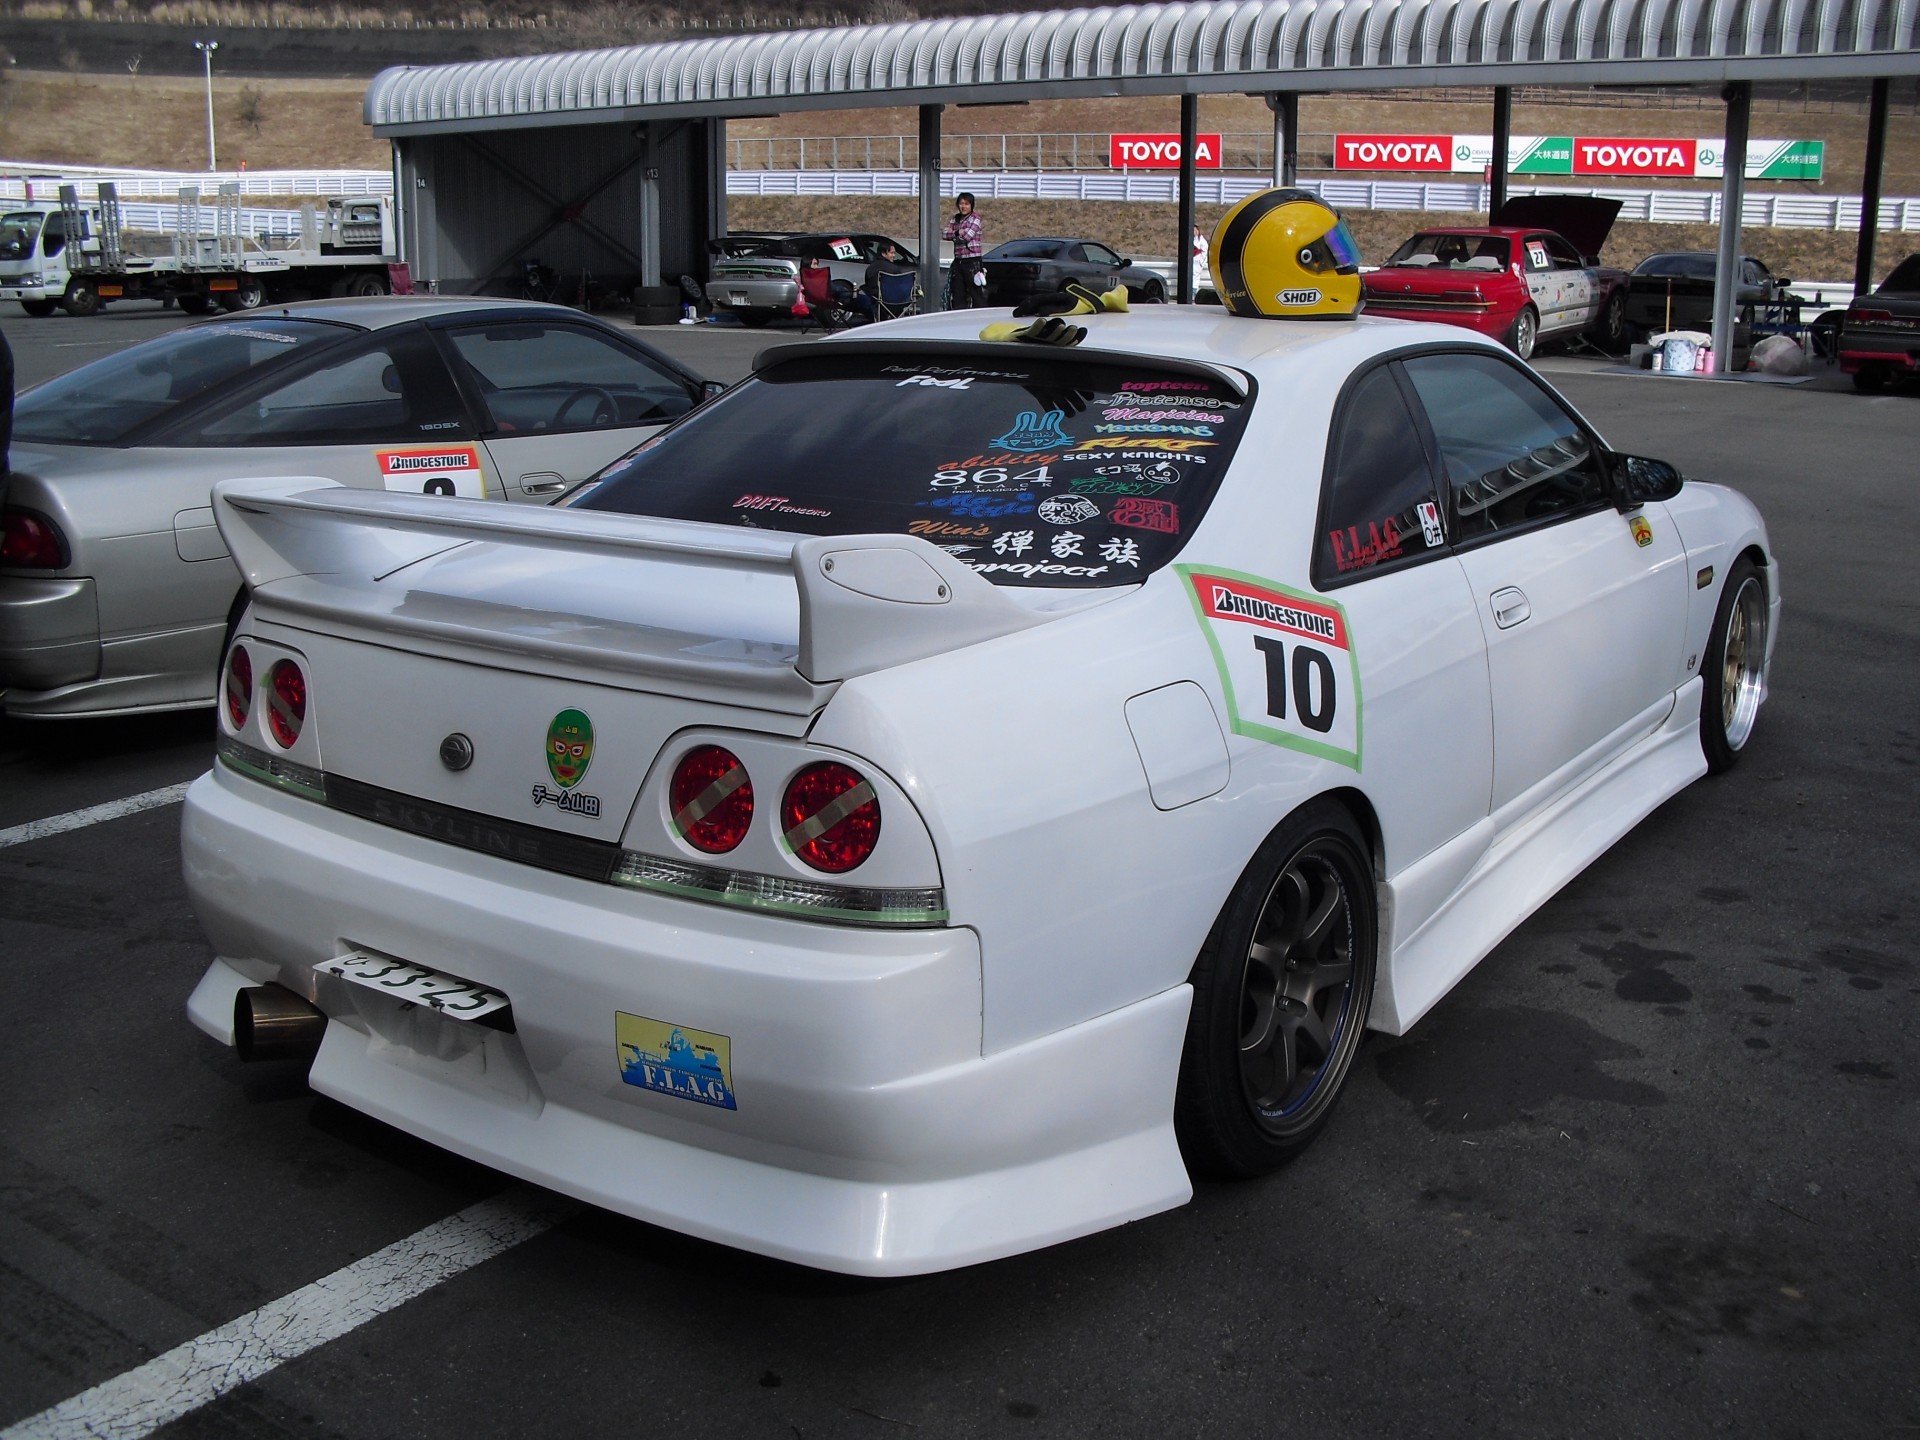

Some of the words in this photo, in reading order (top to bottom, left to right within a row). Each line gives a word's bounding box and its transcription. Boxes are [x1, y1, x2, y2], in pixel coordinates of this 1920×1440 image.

[1119, 142, 1212, 161] TOYOA
[1344, 142, 1443, 163] TOYOTA
[1534, 151, 1570, 160] 大林道路
[1582, 146, 1685, 167] TOYOTA
[1781, 154, 1819, 164] 大林道路
[417, 179, 426, 188] 14
[839, 246, 852, 256] 12
[1534, 251, 1543, 265] 27
[1283, 292, 1317, 303] SHOEI
[1102, 408, 1225, 424] Magician
[389, 454, 469, 471] BRIDGESTONE
[937, 453, 1060, 471] ability
[1063, 453, 1115, 461] SEXY
[930, 466, 1054, 487] 864
[732, 495, 790, 511] DRIFT
[908, 520, 992, 536] Win's
[1215, 588, 1335, 638] BRIDGESTONE
[1253, 635, 1337, 734] 10
[532, 785, 600, 817] チーム山田
[374, 800, 541, 859] SKYLINE
[355, 960, 492, 1011] 33-25
